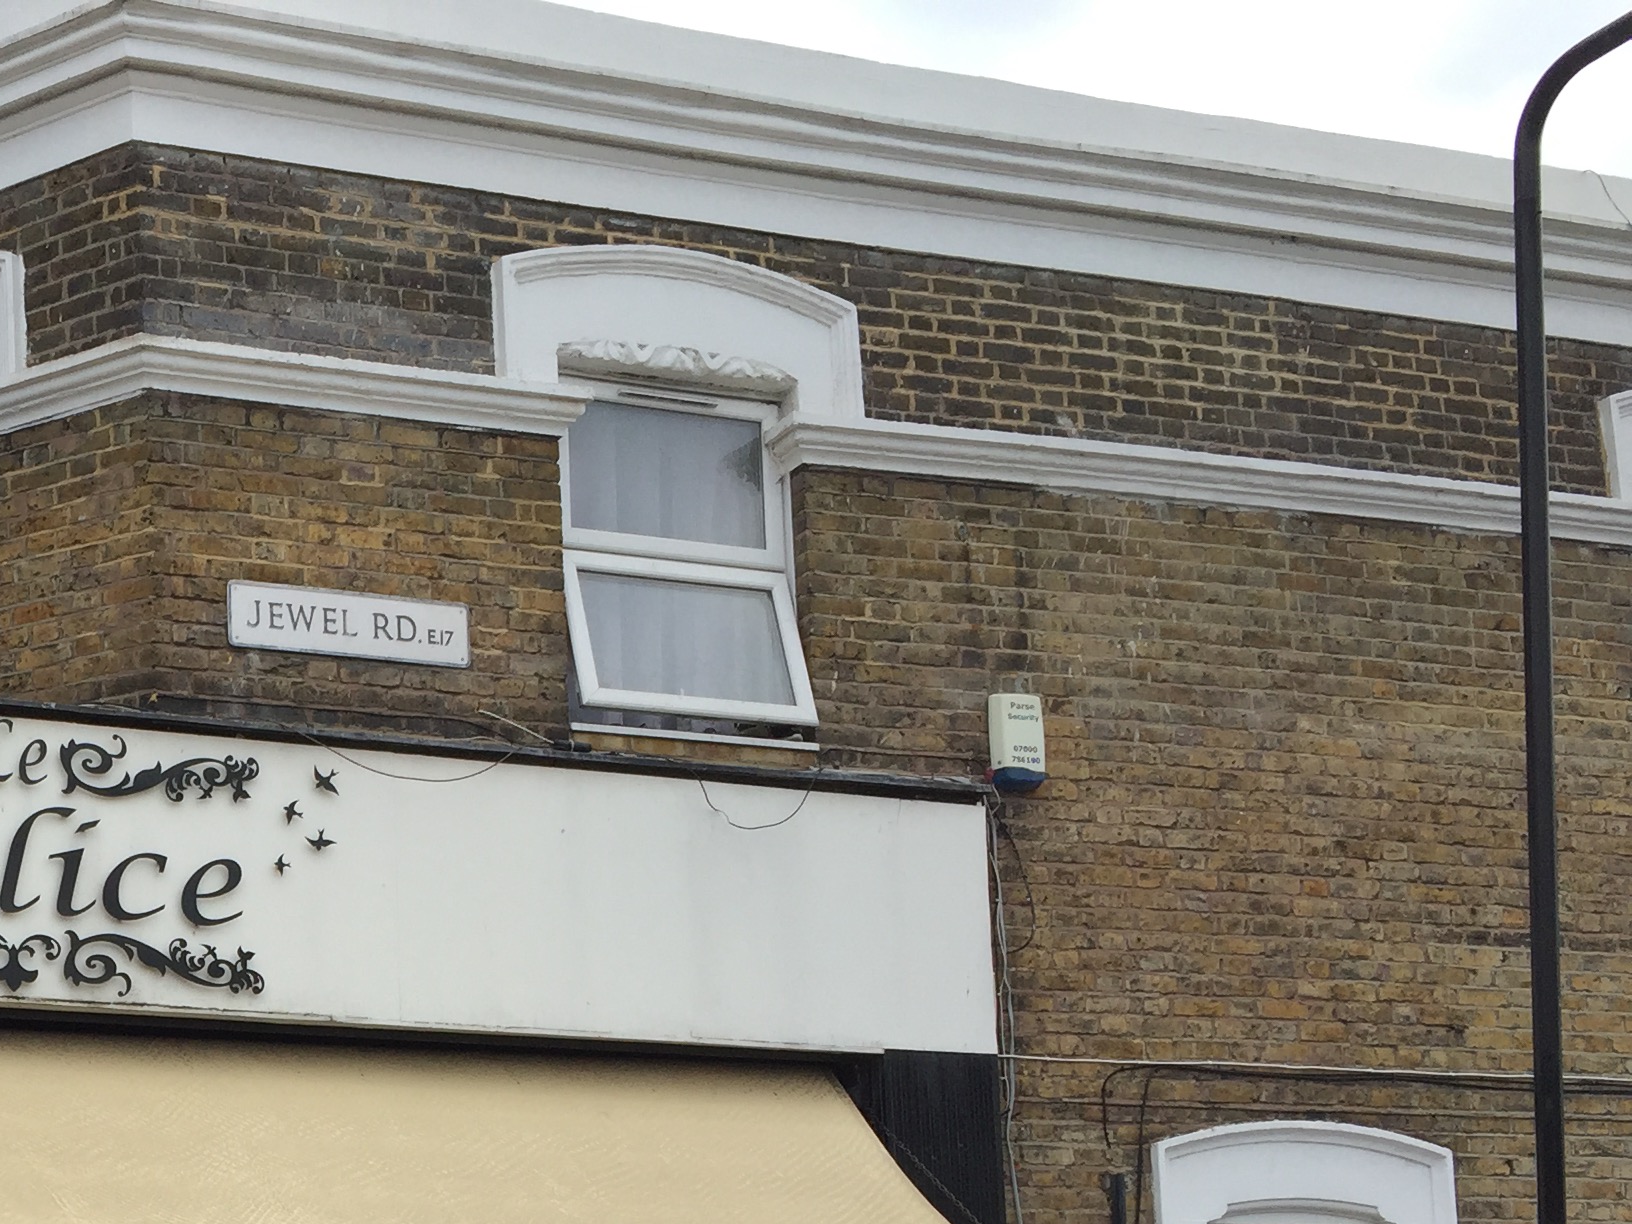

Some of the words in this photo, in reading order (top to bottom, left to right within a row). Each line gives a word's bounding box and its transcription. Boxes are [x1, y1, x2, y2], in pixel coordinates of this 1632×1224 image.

[246, 599, 359, 638] JEWEL
[372, 612, 423, 645] RD.
[428, 628, 455, 647] E.17
